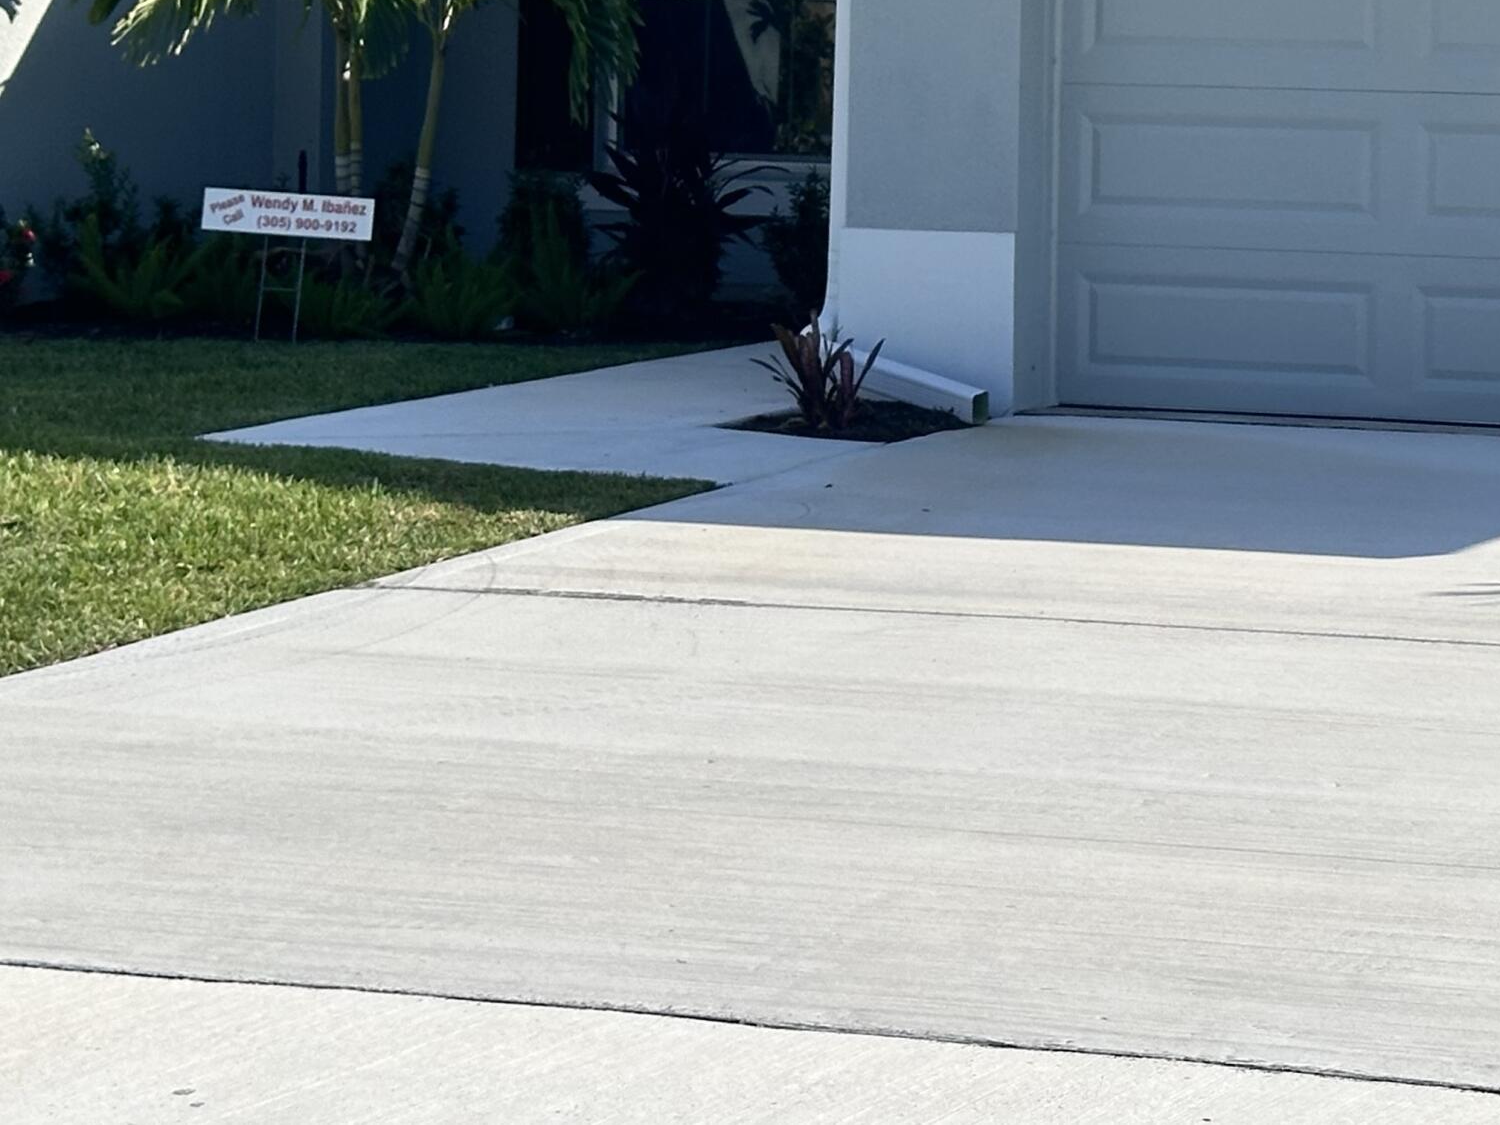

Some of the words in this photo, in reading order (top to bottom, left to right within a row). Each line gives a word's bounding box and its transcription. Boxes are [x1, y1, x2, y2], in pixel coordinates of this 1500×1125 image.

[210, 194, 245, 213] Please
[251, 194, 298, 213] Wendy
[302, 199, 317, 213] M.
[321, 199, 367, 216] Ibañez
[222, 209, 244, 225] Call
[257, 215, 291, 231] (305)
[295, 217, 357, 233] 900-9192
